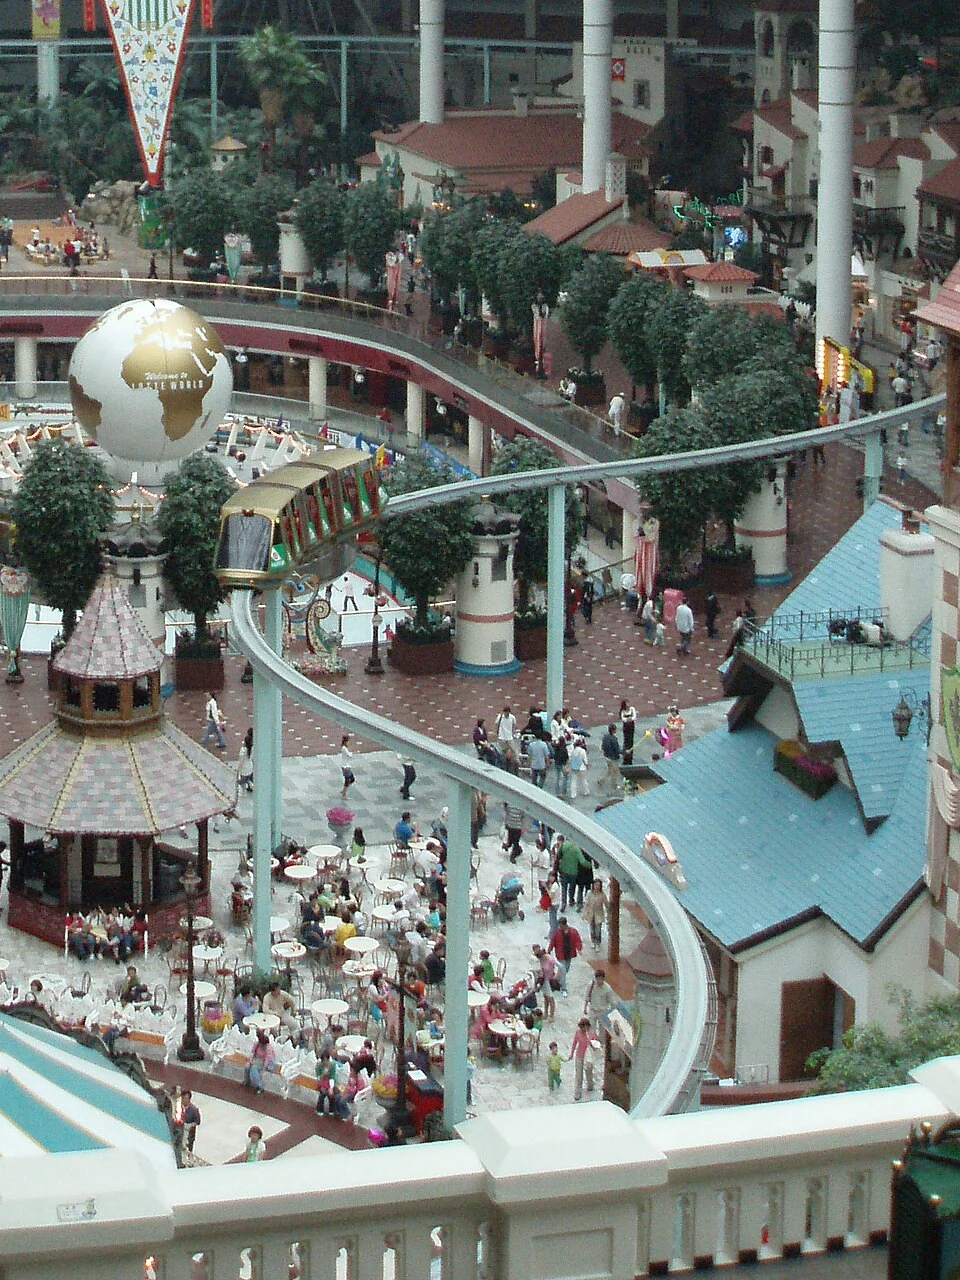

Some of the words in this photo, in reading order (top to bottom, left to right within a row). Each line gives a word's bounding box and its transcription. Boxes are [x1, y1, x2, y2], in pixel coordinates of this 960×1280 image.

[145, 371, 179, 380] Welcome
[132, 381, 165, 391] LOTTE
[170, 380, 203, 390] WORLD
